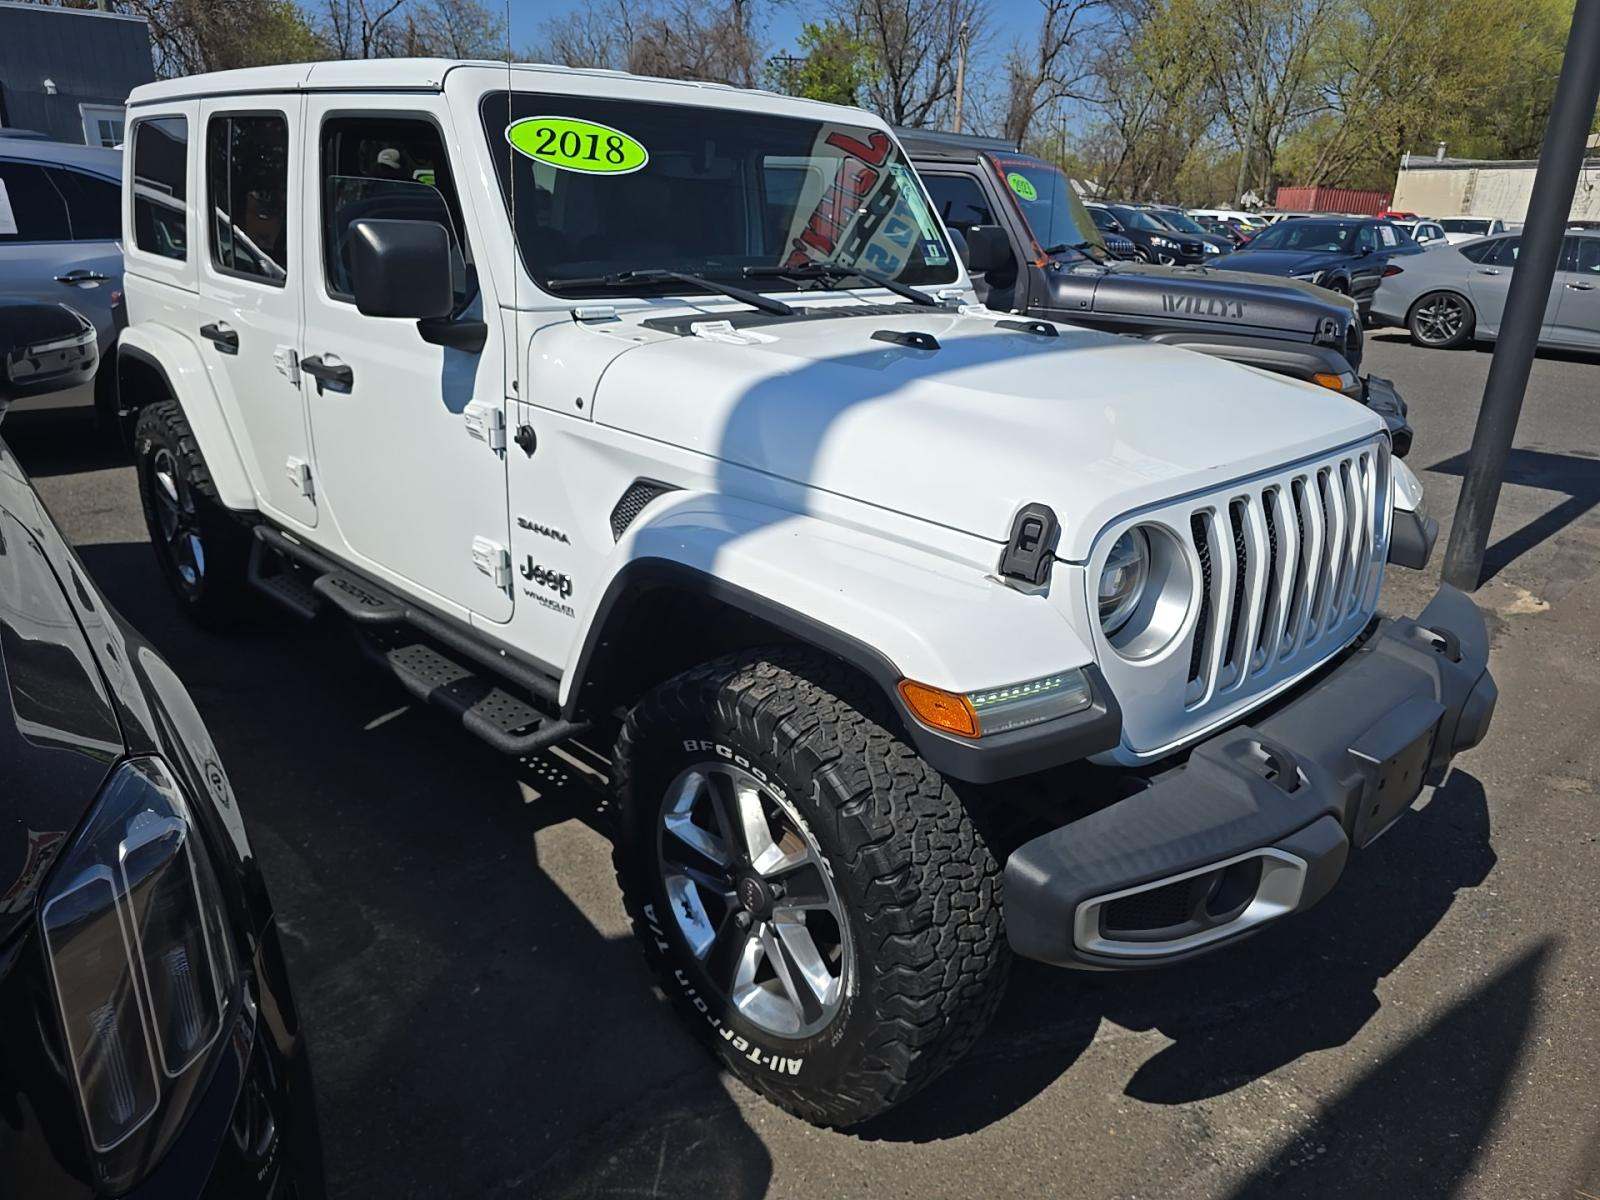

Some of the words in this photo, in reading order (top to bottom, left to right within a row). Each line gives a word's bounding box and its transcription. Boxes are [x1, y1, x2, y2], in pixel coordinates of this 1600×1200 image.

[535, 127, 625, 164] 2018
[1162, 294, 1248, 319] WILLYS
[517, 517, 571, 545] SAHARA
[520, 554, 573, 600] Jeep
